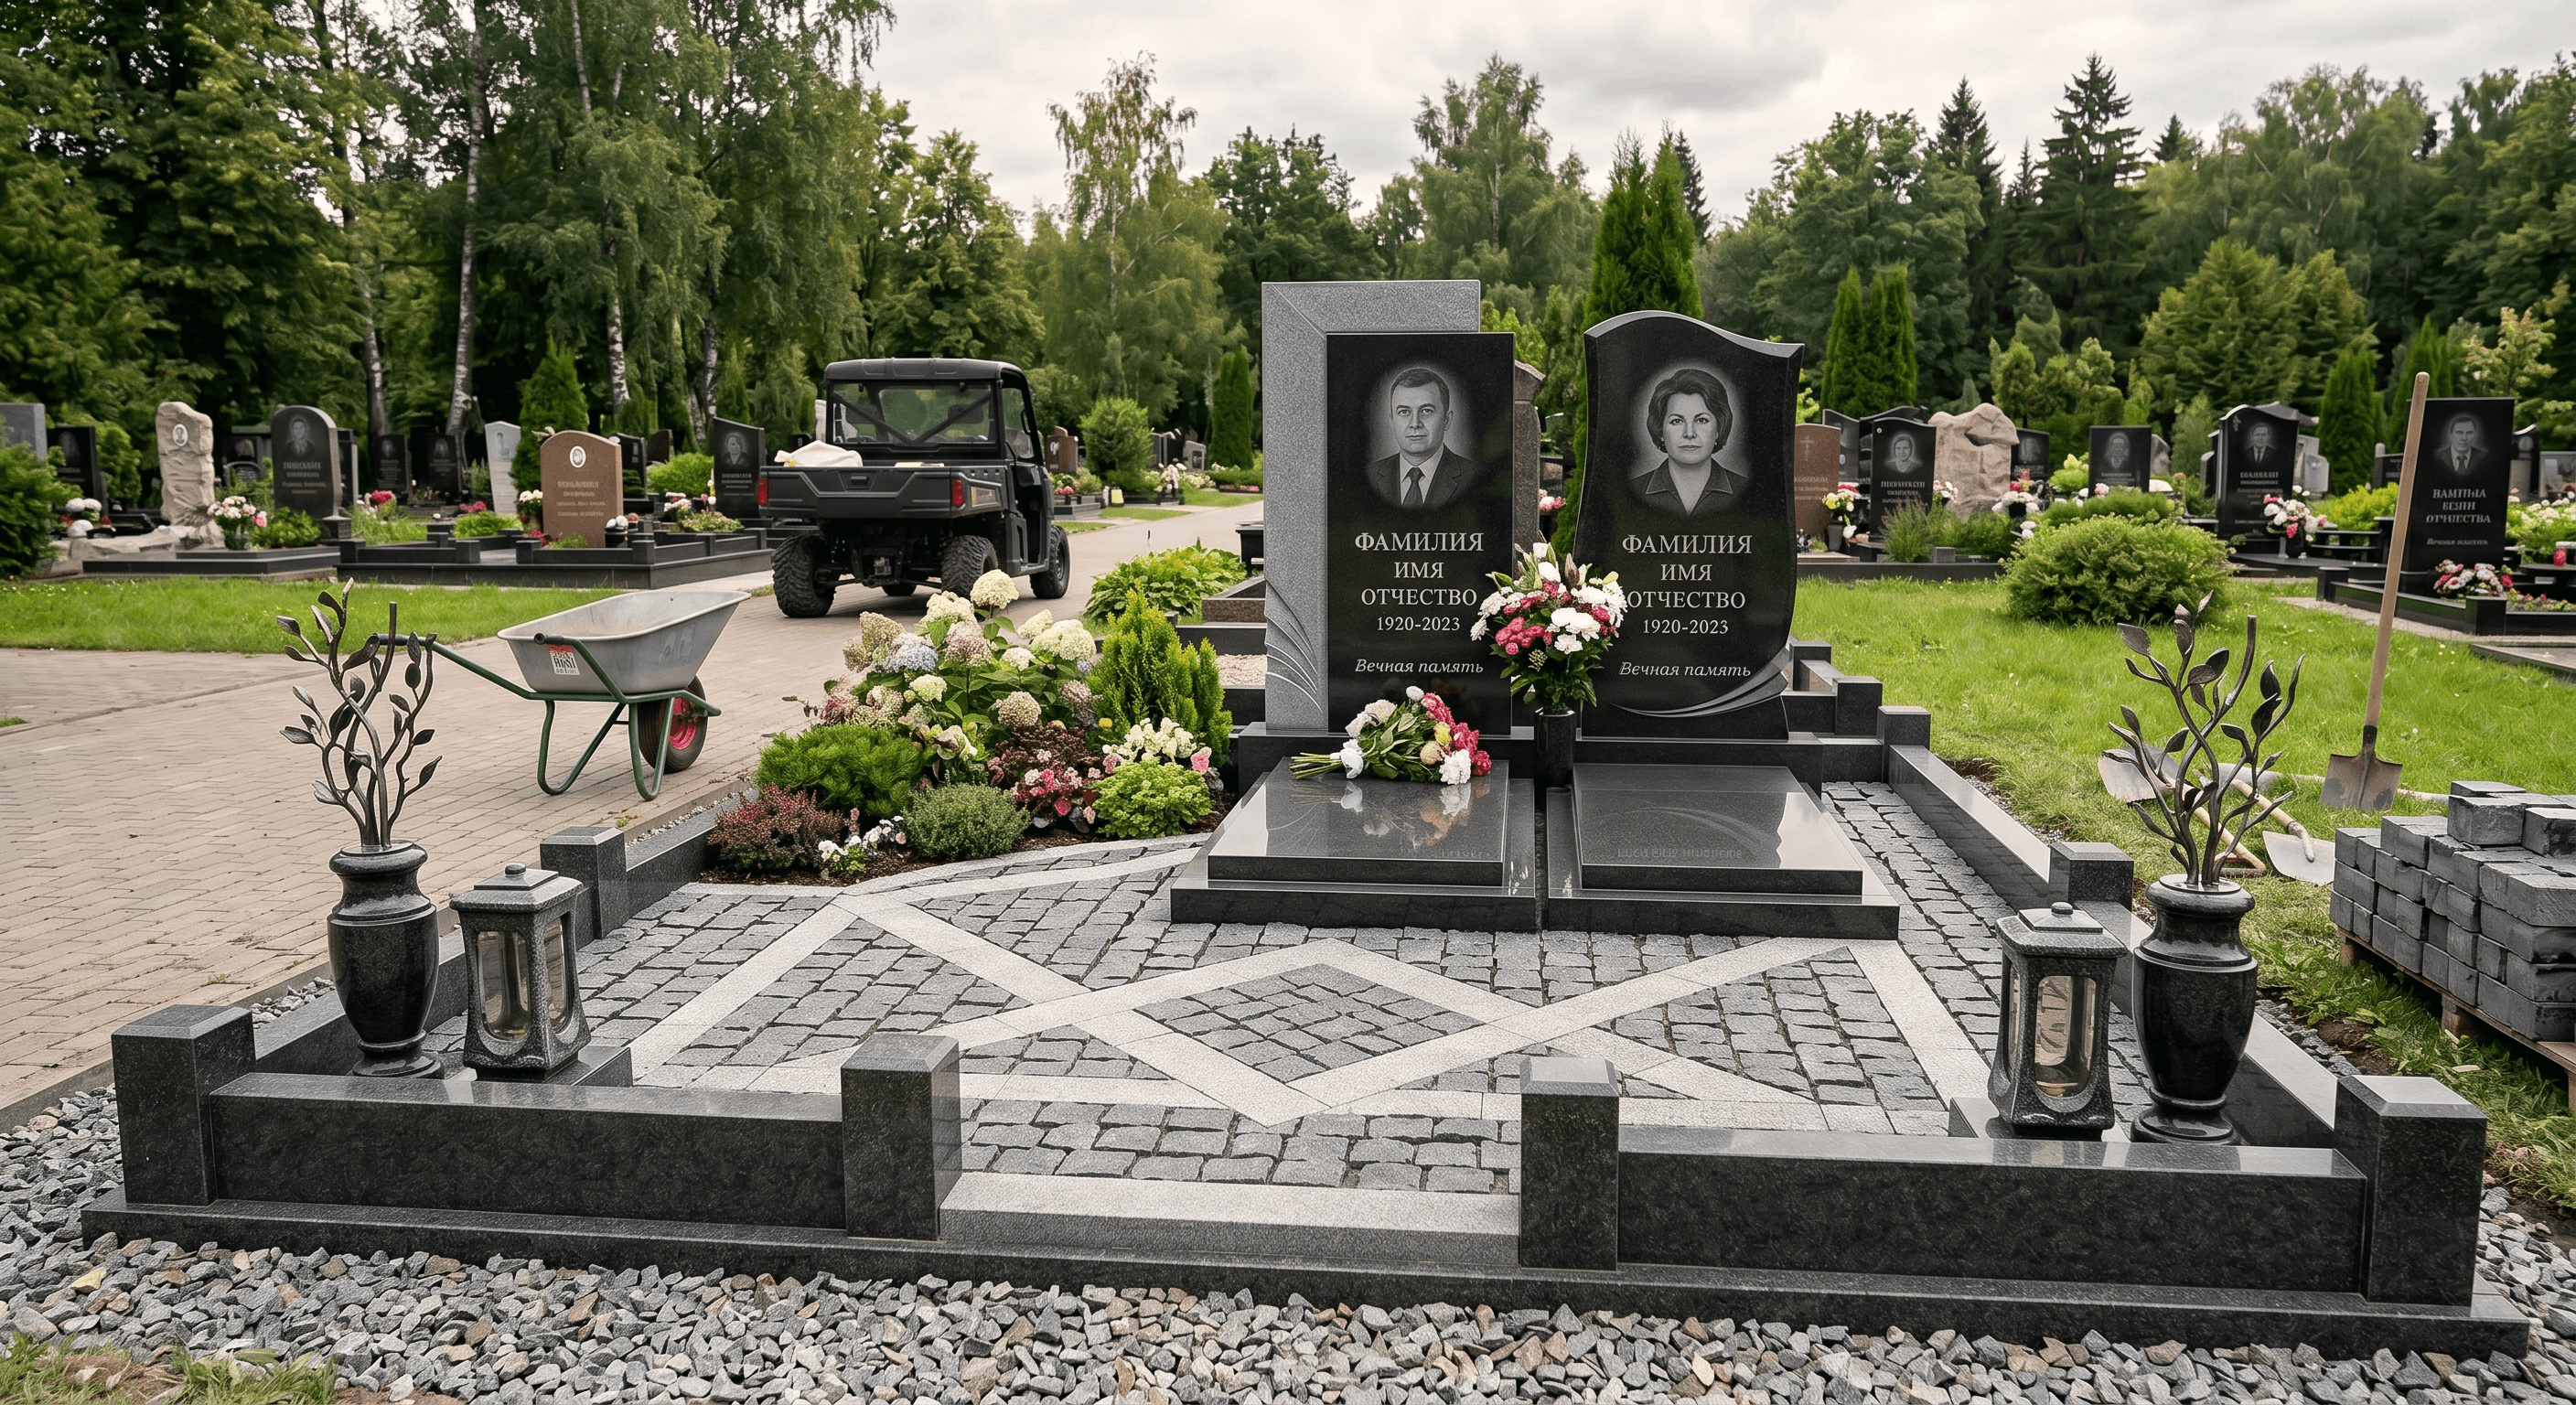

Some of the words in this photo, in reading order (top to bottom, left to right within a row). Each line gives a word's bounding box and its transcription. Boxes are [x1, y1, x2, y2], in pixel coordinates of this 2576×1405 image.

[1355, 532, 1484, 552] ФАМИЛИЯ
[1622, 534, 1753, 554] ФАМИЛИЯ
[1393, 562, 1444, 579] ИМЯ
[1660, 563, 1712, 581] ИМЯ
[1360, 588, 1477, 606] ОТЧЕСТВО
[1626, 591, 1746, 609] ОТЧЕСТВО
[1377, 616, 1460, 631] 1920-2023
[1643, 618, 1729, 635] 1920-2023
[1355, 659, 1413, 673] Вечная
[1418, 662, 1484, 673] память
[1619, 661, 1680, 676] Вечная
[1684, 665, 1751, 677] память
